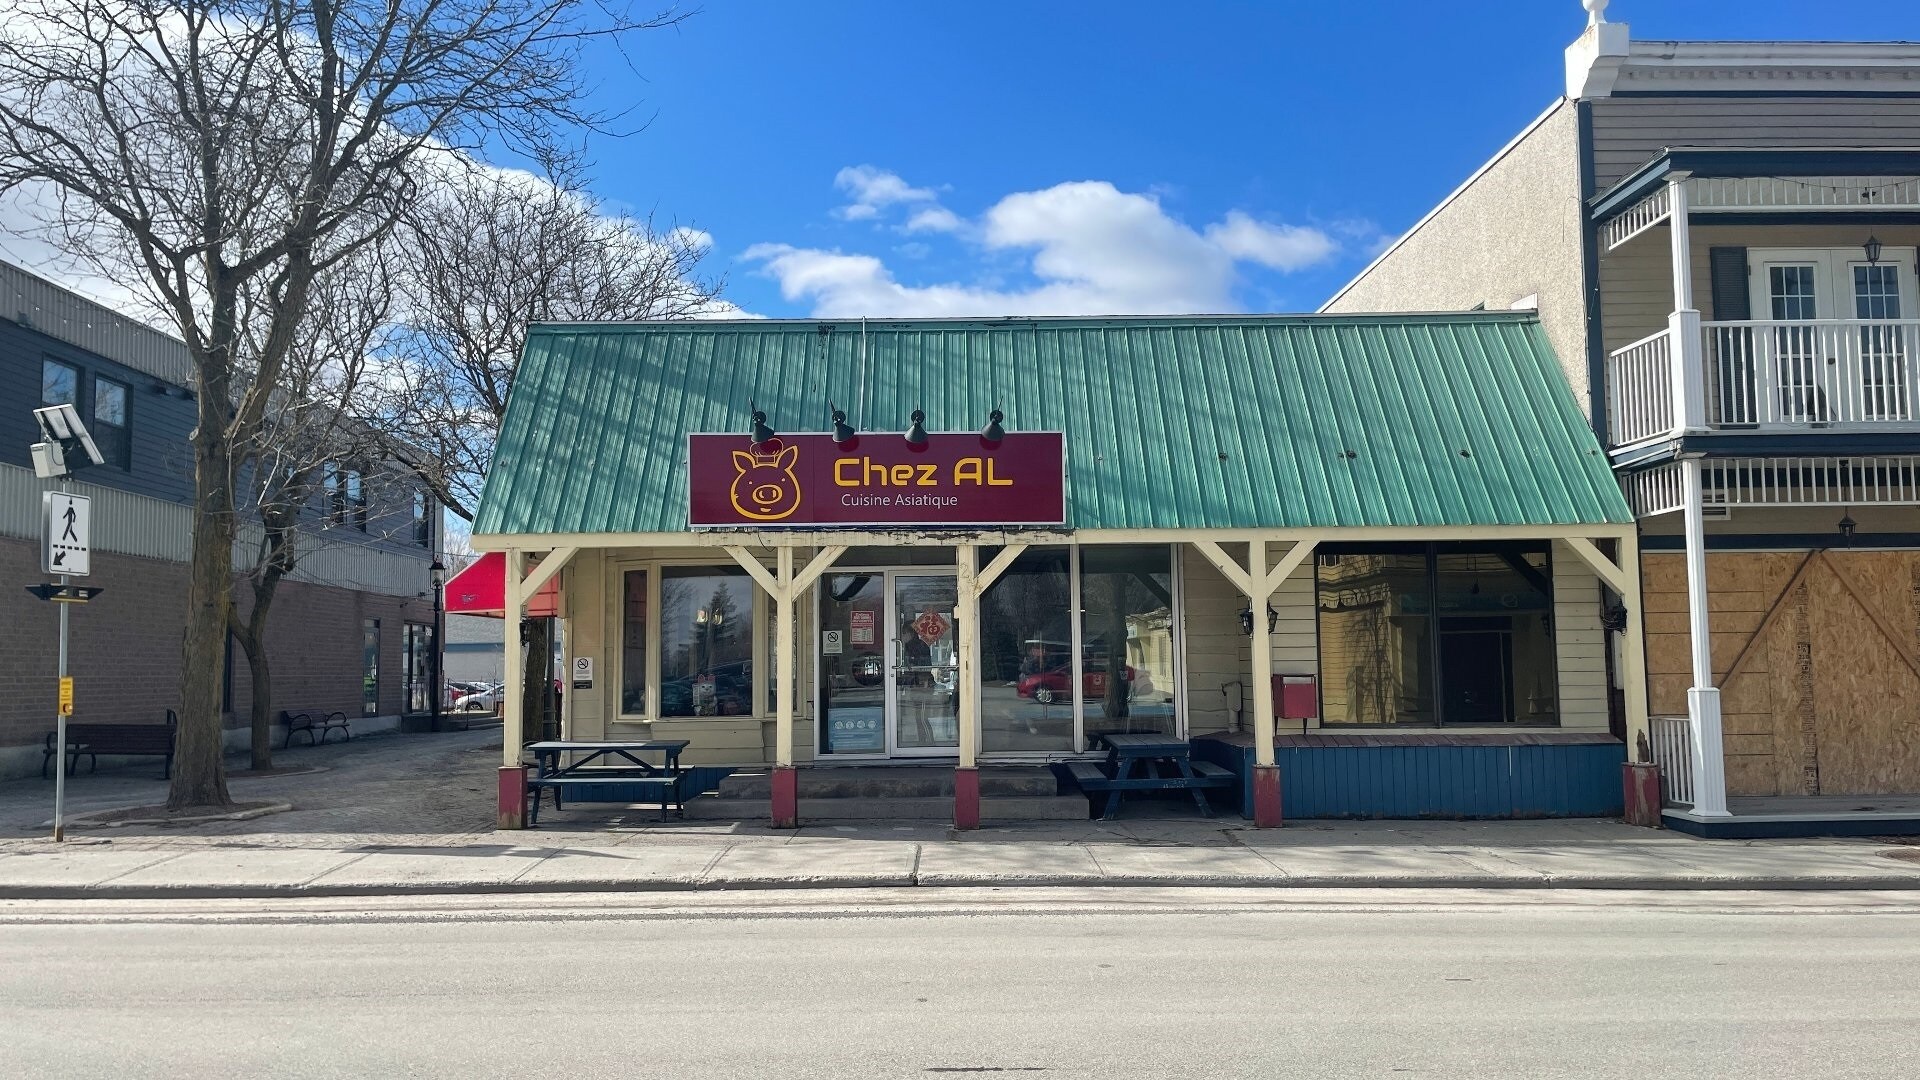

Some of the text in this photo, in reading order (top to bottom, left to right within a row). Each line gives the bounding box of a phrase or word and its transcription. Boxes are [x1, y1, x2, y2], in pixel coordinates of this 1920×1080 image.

[835, 457, 1012, 486] Chez AL
[842, 494, 957, 509] Cuisine Asiatique
